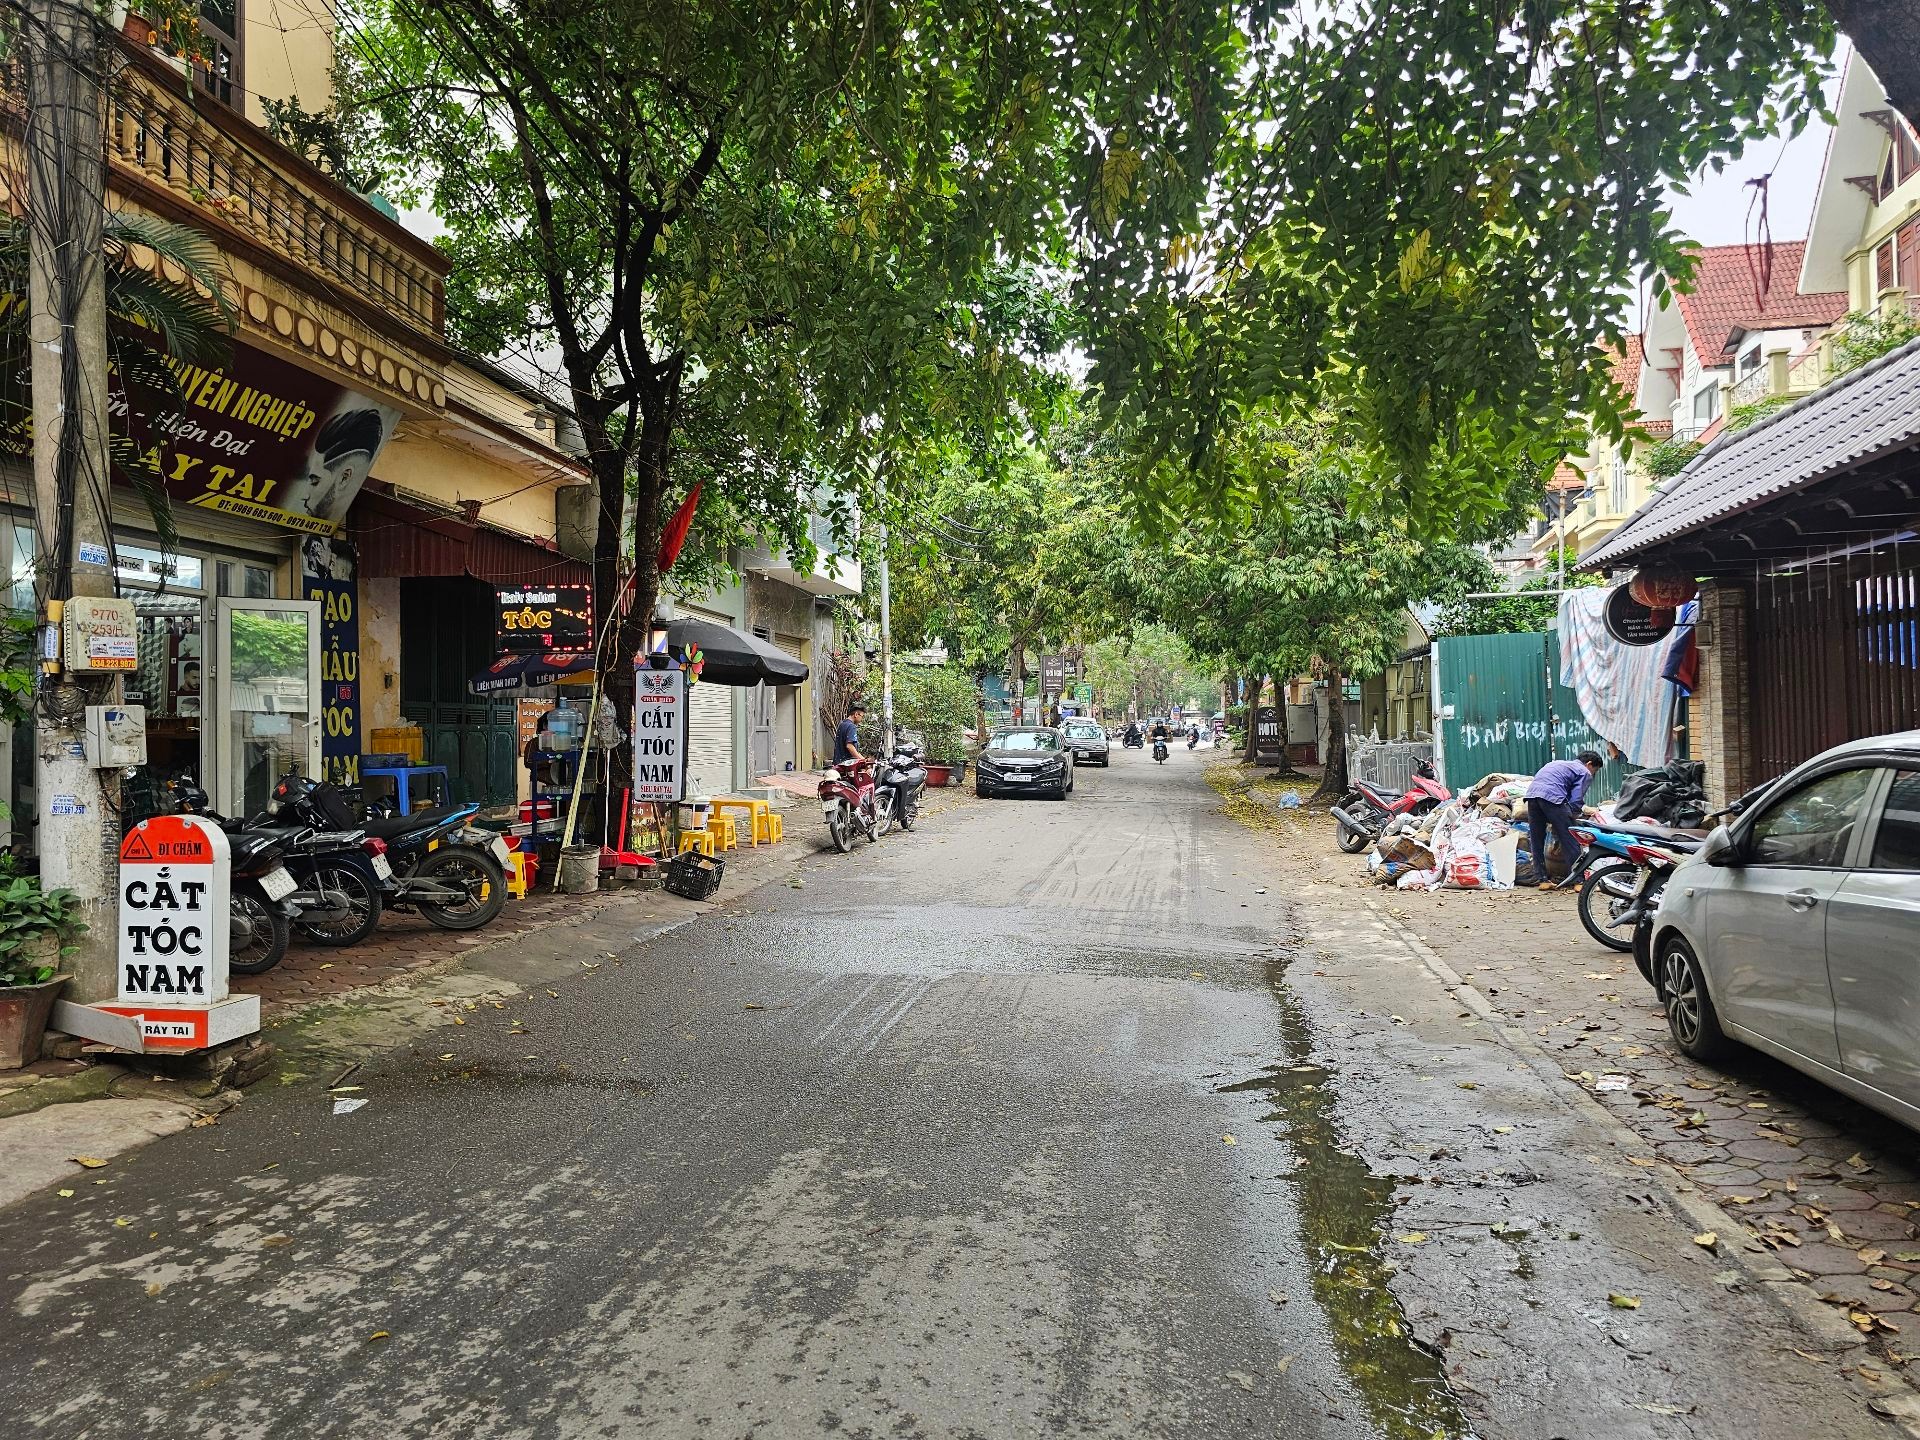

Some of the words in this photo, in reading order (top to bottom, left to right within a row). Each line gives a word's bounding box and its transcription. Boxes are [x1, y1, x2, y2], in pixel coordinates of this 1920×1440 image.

[230, 386, 316, 442] NGHIỆP
[209, 429, 256, 456] Đại
[205, 464, 278, 503] TAI
[231, 502, 254, 516] 0969
[319, 523, 333, 534] 138
[129, 561, 140, 570] TÓC
[502, 606, 552, 629] TÓC
[641, 705, 675, 729] CẮT
[1258, 722, 1279, 736] HOTE
[640, 735, 675, 756] TÓC
[640, 764, 674, 783] NAM
[158, 843, 170, 856] ĐI
[173, 840, 202, 857] CHẬM
[125, 866, 207, 911] CẮT
[127, 917, 203, 957] TÓC
[125, 964, 205, 995] NAM
[145, 1024, 168, 1035] RÁY
[171, 1026, 189, 1036] TAI
